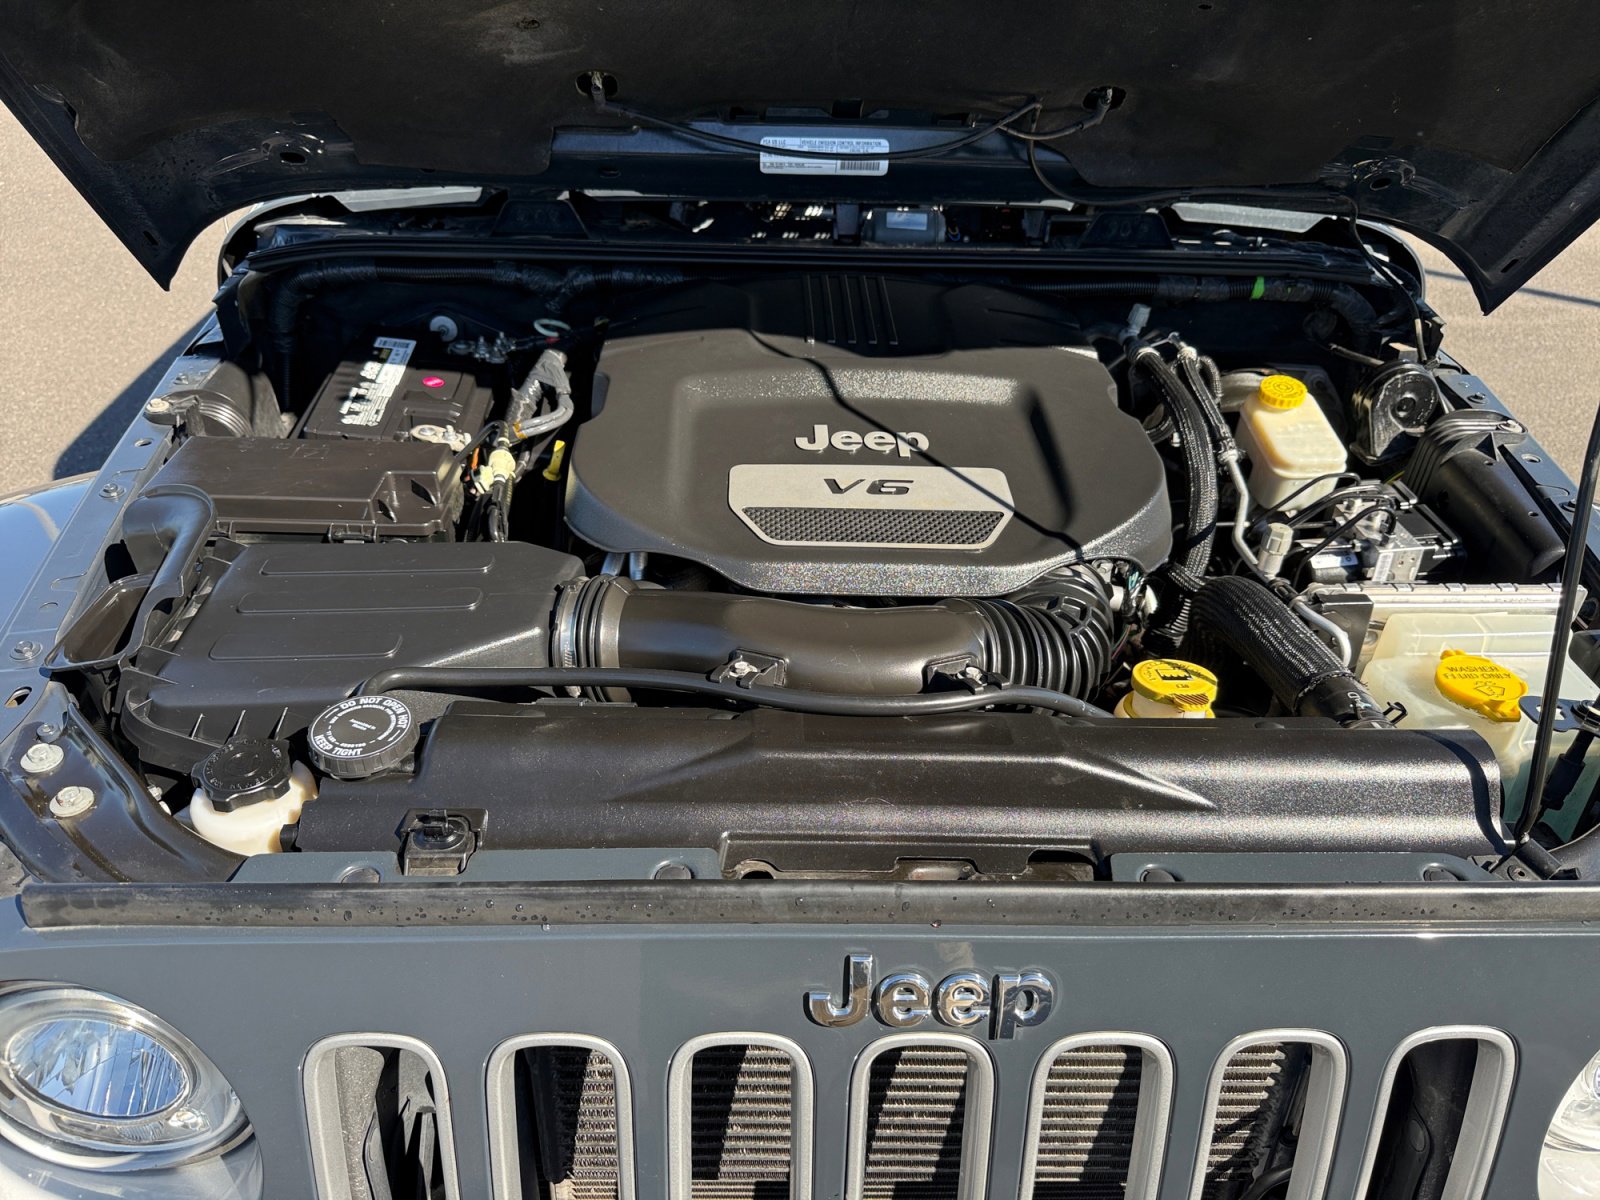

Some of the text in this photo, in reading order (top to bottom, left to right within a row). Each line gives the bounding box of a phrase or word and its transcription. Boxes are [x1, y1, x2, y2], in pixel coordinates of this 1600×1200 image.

[795, 424, 929, 457] Jeep
[823, 478, 914, 495] V6
[340, 700, 357, 710] DO
[359, 697, 383, 705] NOT
[382, 699, 406, 715] OPEN
[396, 714, 409, 729] HOT
[314, 734, 334, 751] KEEP
[332, 747, 363, 756] TIGHT
[803, 954, 1054, 1040] Jeep
